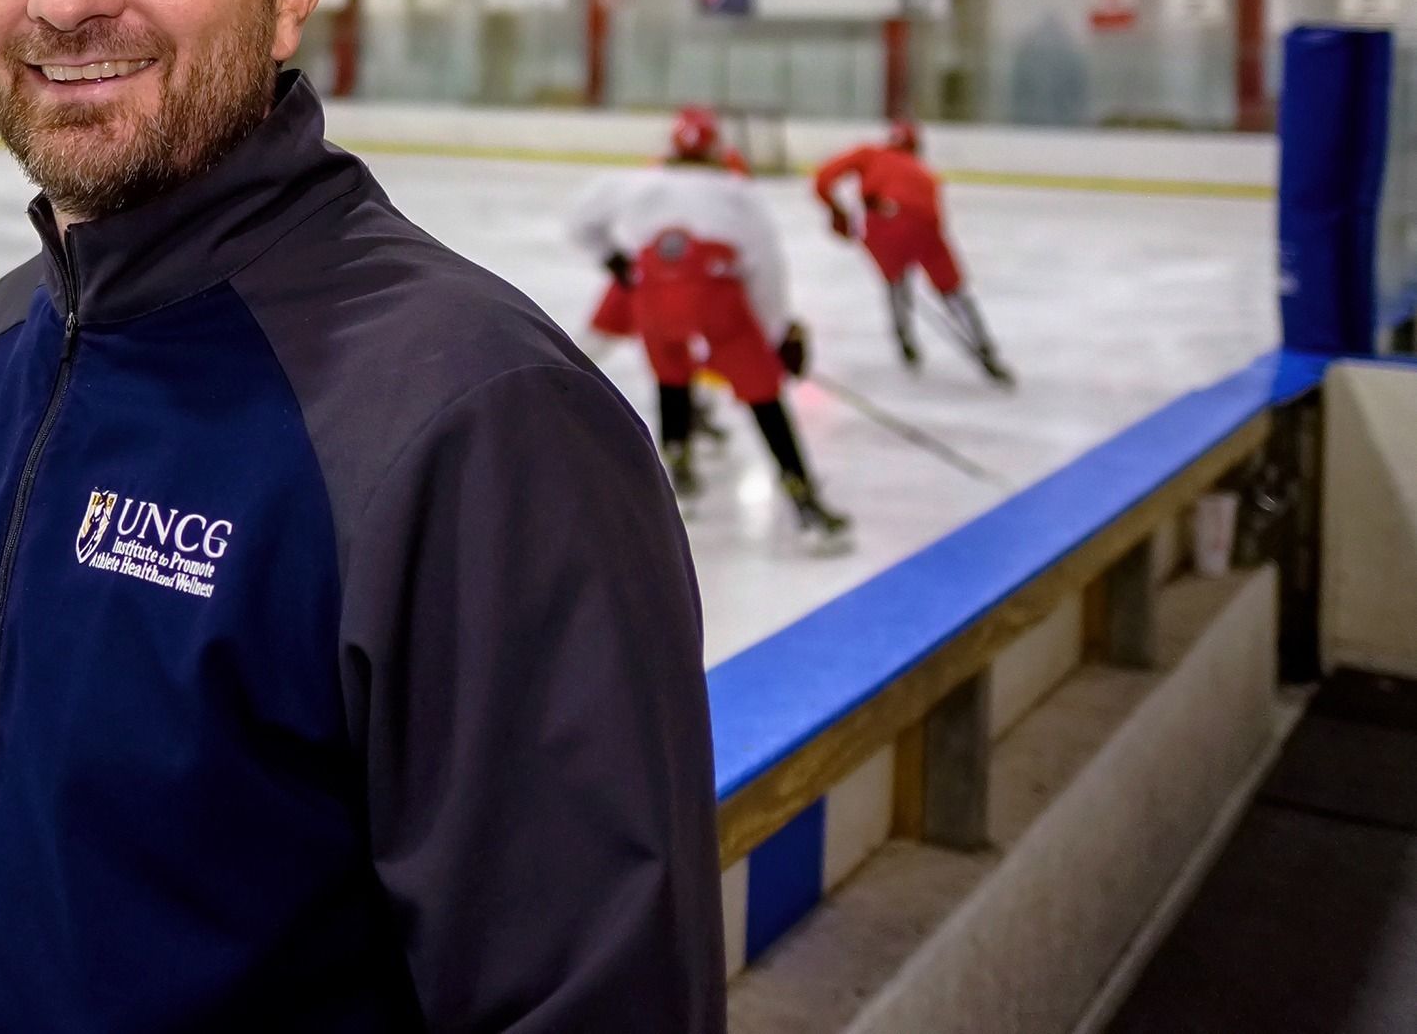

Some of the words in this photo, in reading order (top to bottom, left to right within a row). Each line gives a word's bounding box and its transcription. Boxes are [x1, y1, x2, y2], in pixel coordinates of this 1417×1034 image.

[117, 498, 233, 558] UNCG
[89, 552, 120, 572] Athlete
[119, 554, 159, 583] Health
[157, 572, 177, 587] and
[175, 572, 215, 598] Wellness
[112, 536, 156, 563] Institute
[158, 552, 169, 566] to
[169, 551, 215, 578] Promote
